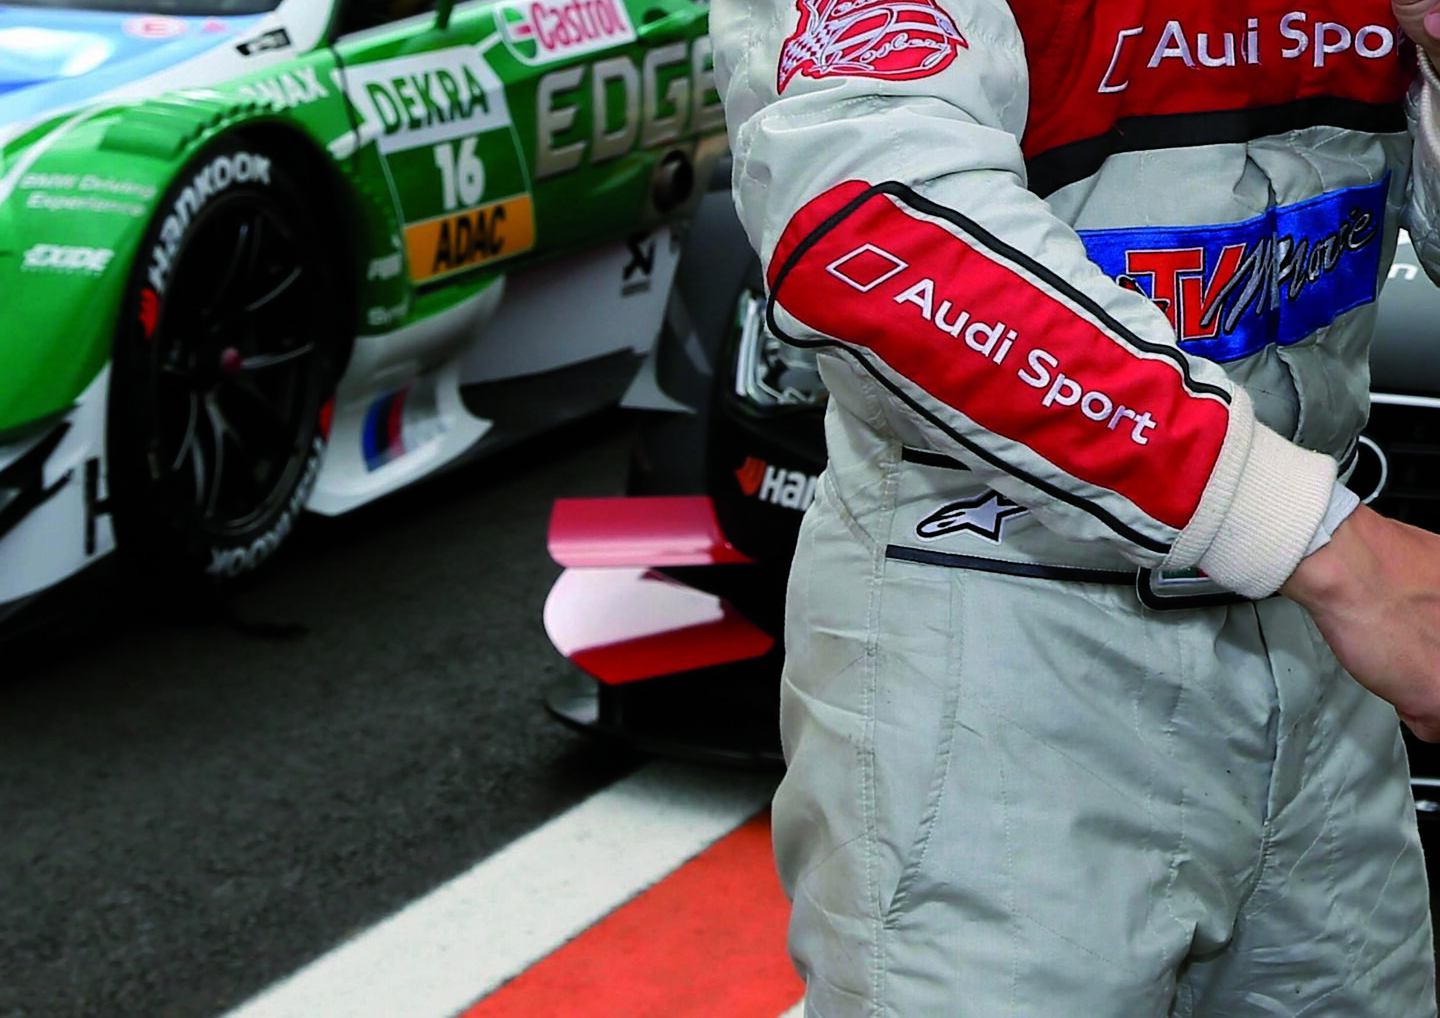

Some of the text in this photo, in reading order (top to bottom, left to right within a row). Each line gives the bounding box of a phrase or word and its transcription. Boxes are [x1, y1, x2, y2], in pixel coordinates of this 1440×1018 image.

[1279, 11, 1396, 68] Spo
[365, 66, 489, 135] DEKRA
[535, 35, 726, 179] EDGE
[434, 136, 486, 210] 16
[432, 204, 507, 274] ADAC
[1125, 208, 1376, 342] TV Movie
[893, 277, 1157, 446] Audi Sport
